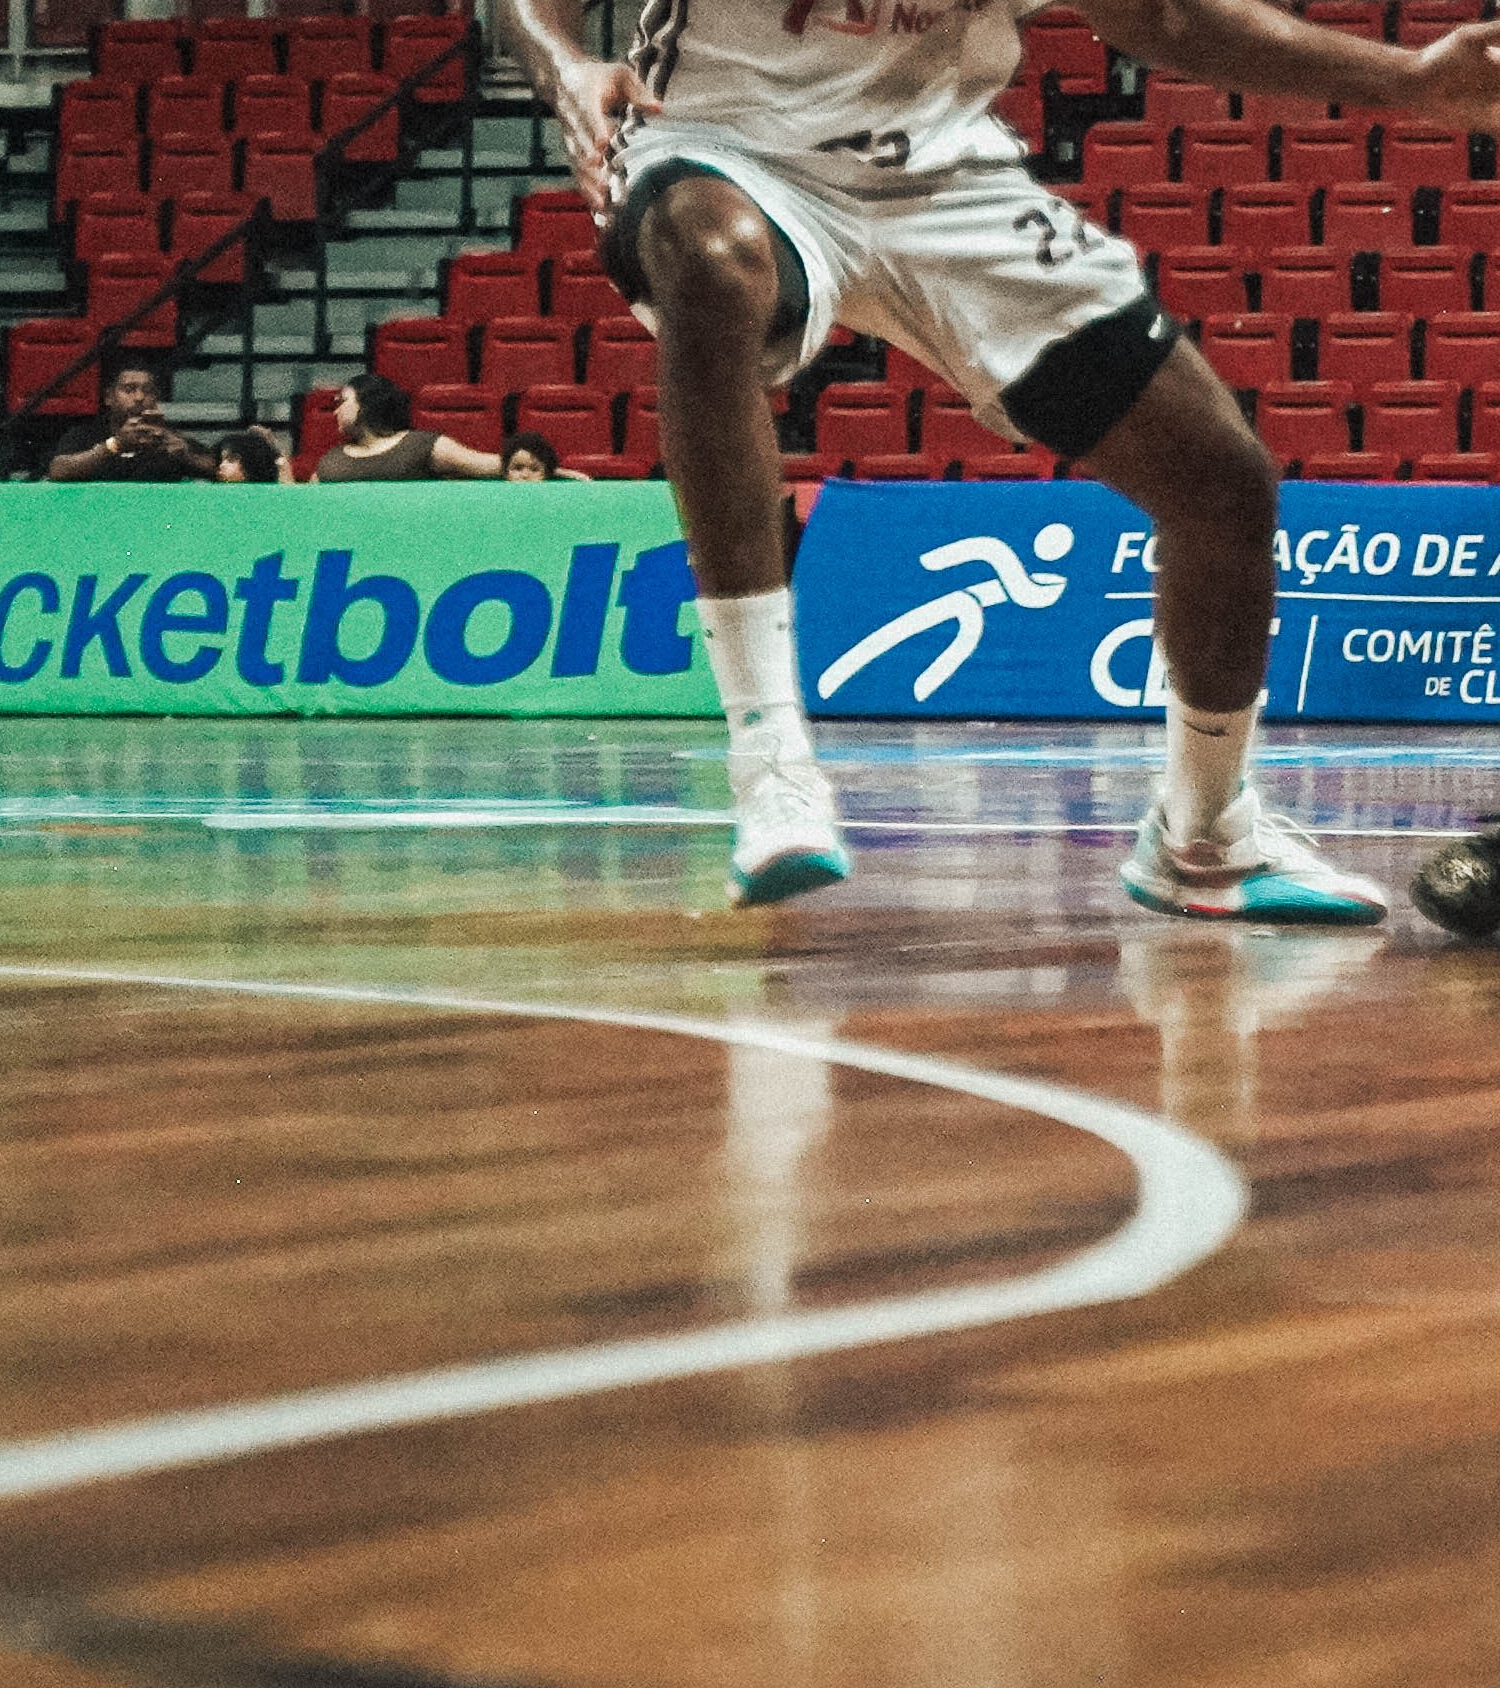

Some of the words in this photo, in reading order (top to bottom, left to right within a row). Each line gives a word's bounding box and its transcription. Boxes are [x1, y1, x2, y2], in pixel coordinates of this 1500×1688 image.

[1411, 533, 1485, 577] DE
[1342, 622, 1497, 664] COMITÊ
[1424, 676, 1453, 697] DE
